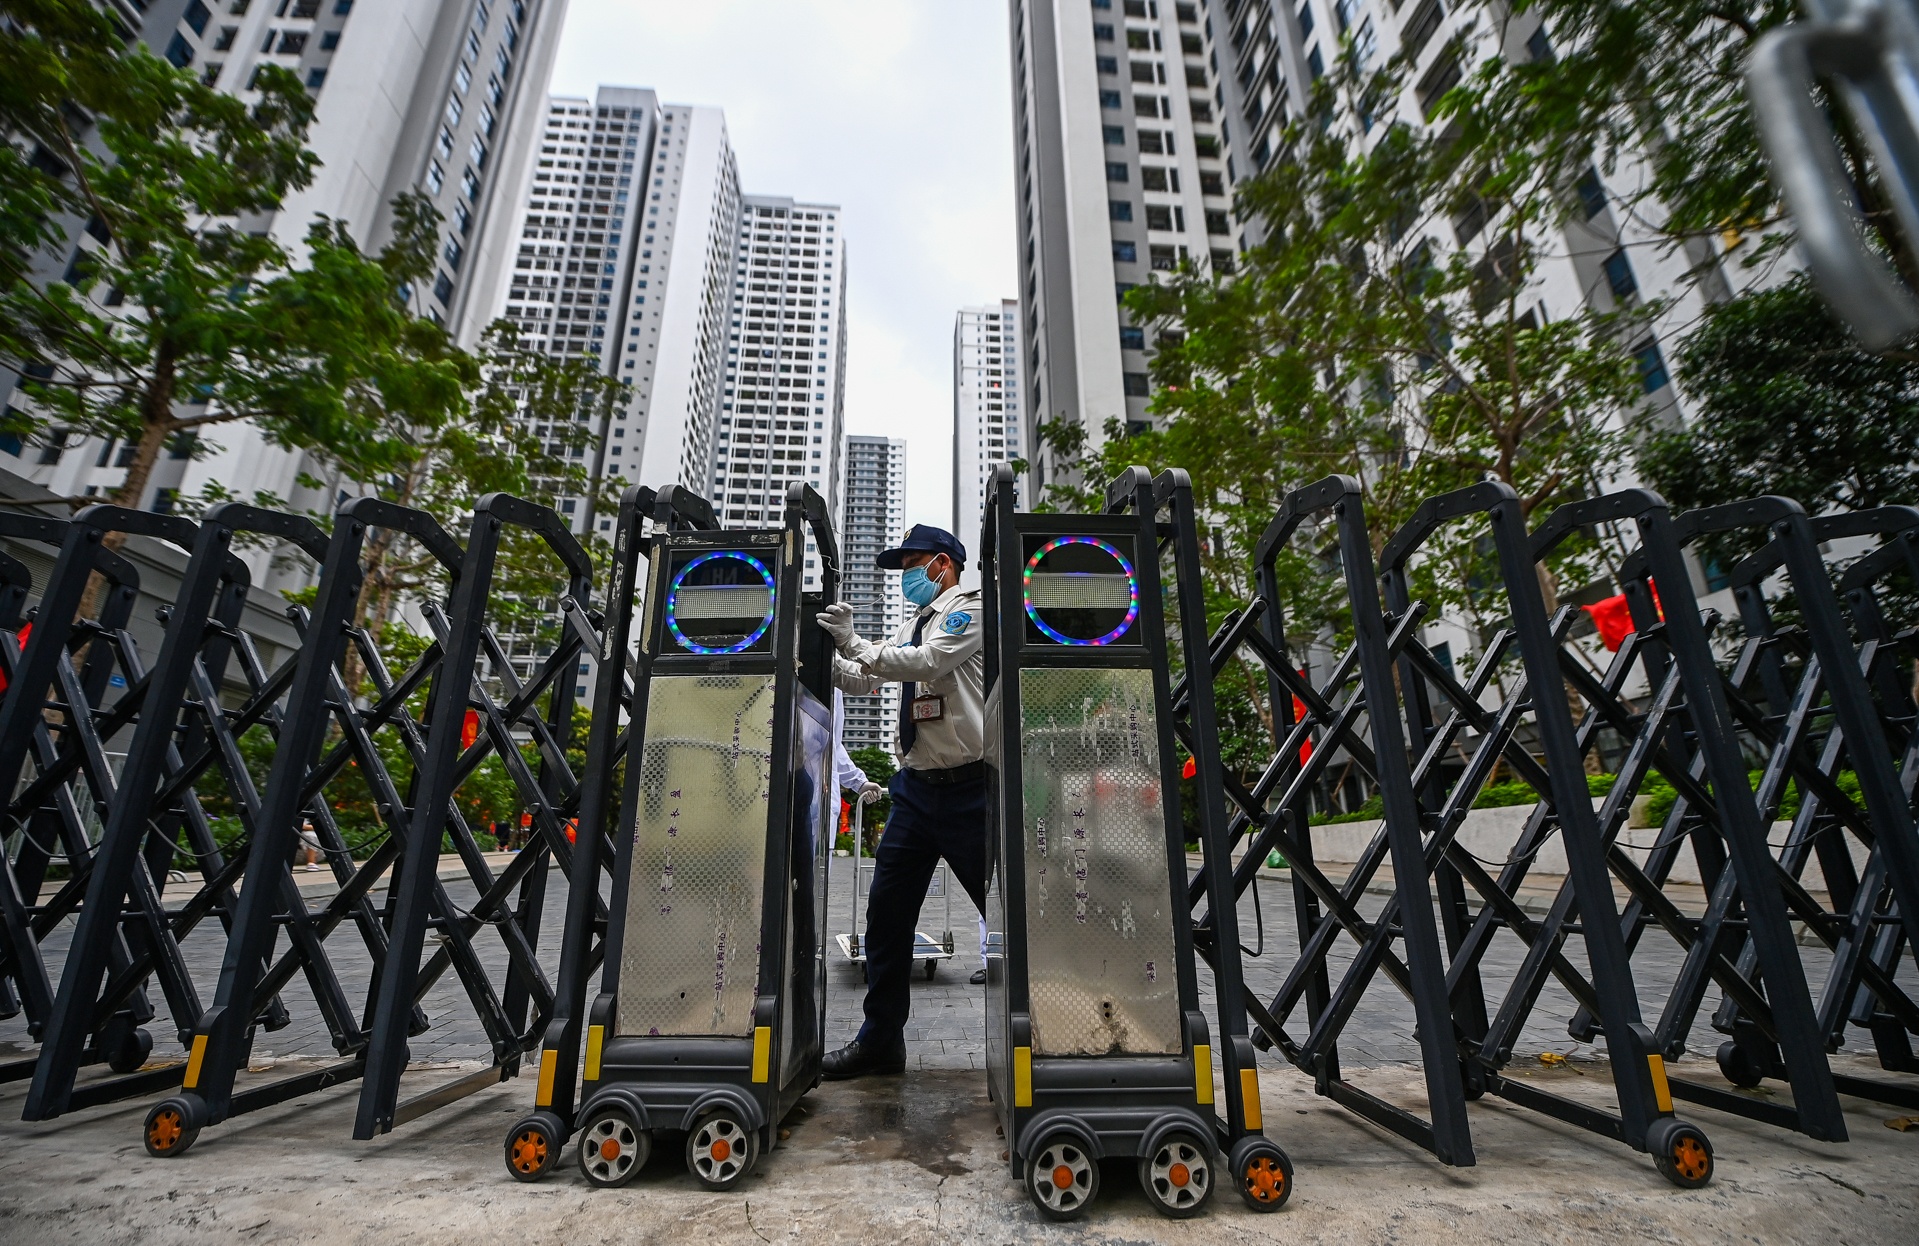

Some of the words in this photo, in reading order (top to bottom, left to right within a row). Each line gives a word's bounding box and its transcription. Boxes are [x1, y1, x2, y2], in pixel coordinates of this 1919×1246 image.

[1070, 792, 1089, 924] 富贵临门源长
[715, 932, 726, 1001] 一站式采购中心
